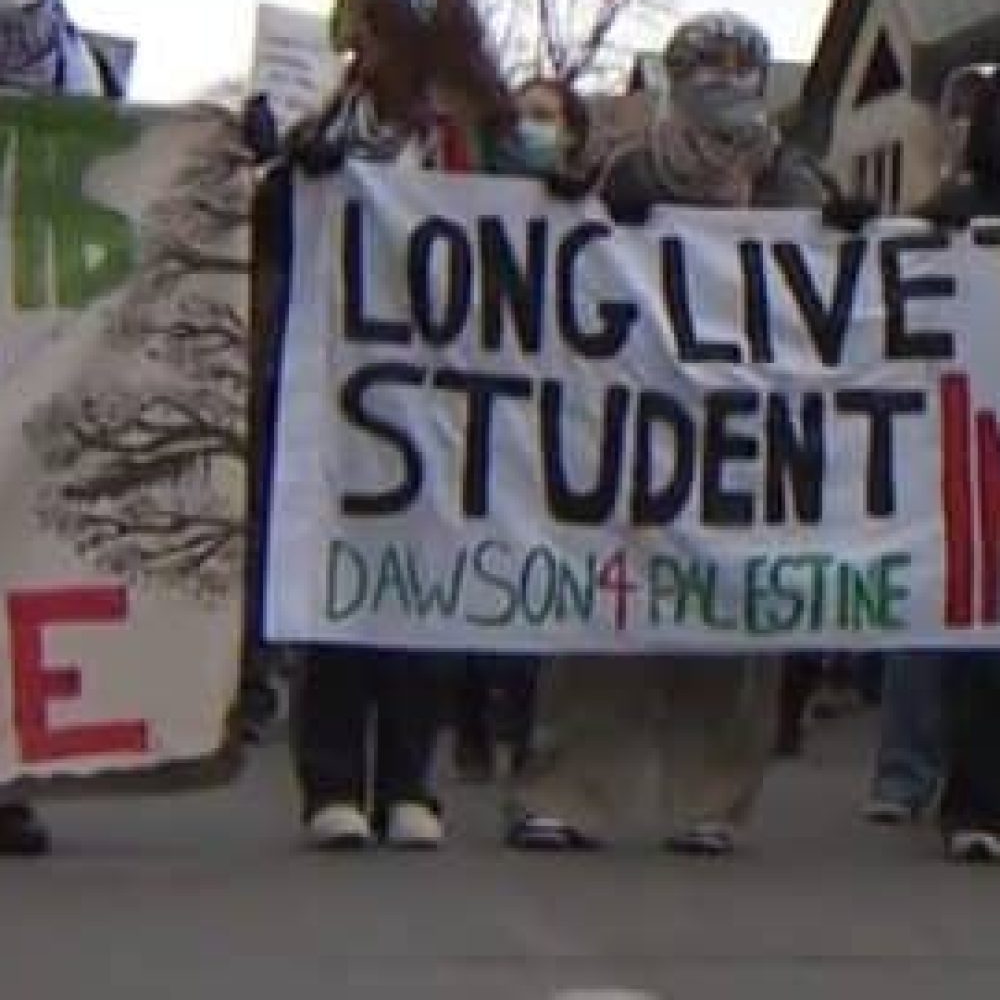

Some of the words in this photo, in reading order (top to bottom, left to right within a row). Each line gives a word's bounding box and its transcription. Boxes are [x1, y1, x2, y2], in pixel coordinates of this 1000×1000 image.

[342, 200, 638, 359] LONG
[661, 227, 956, 366] LIVE
[340, 363, 925, 528] STUDENT
